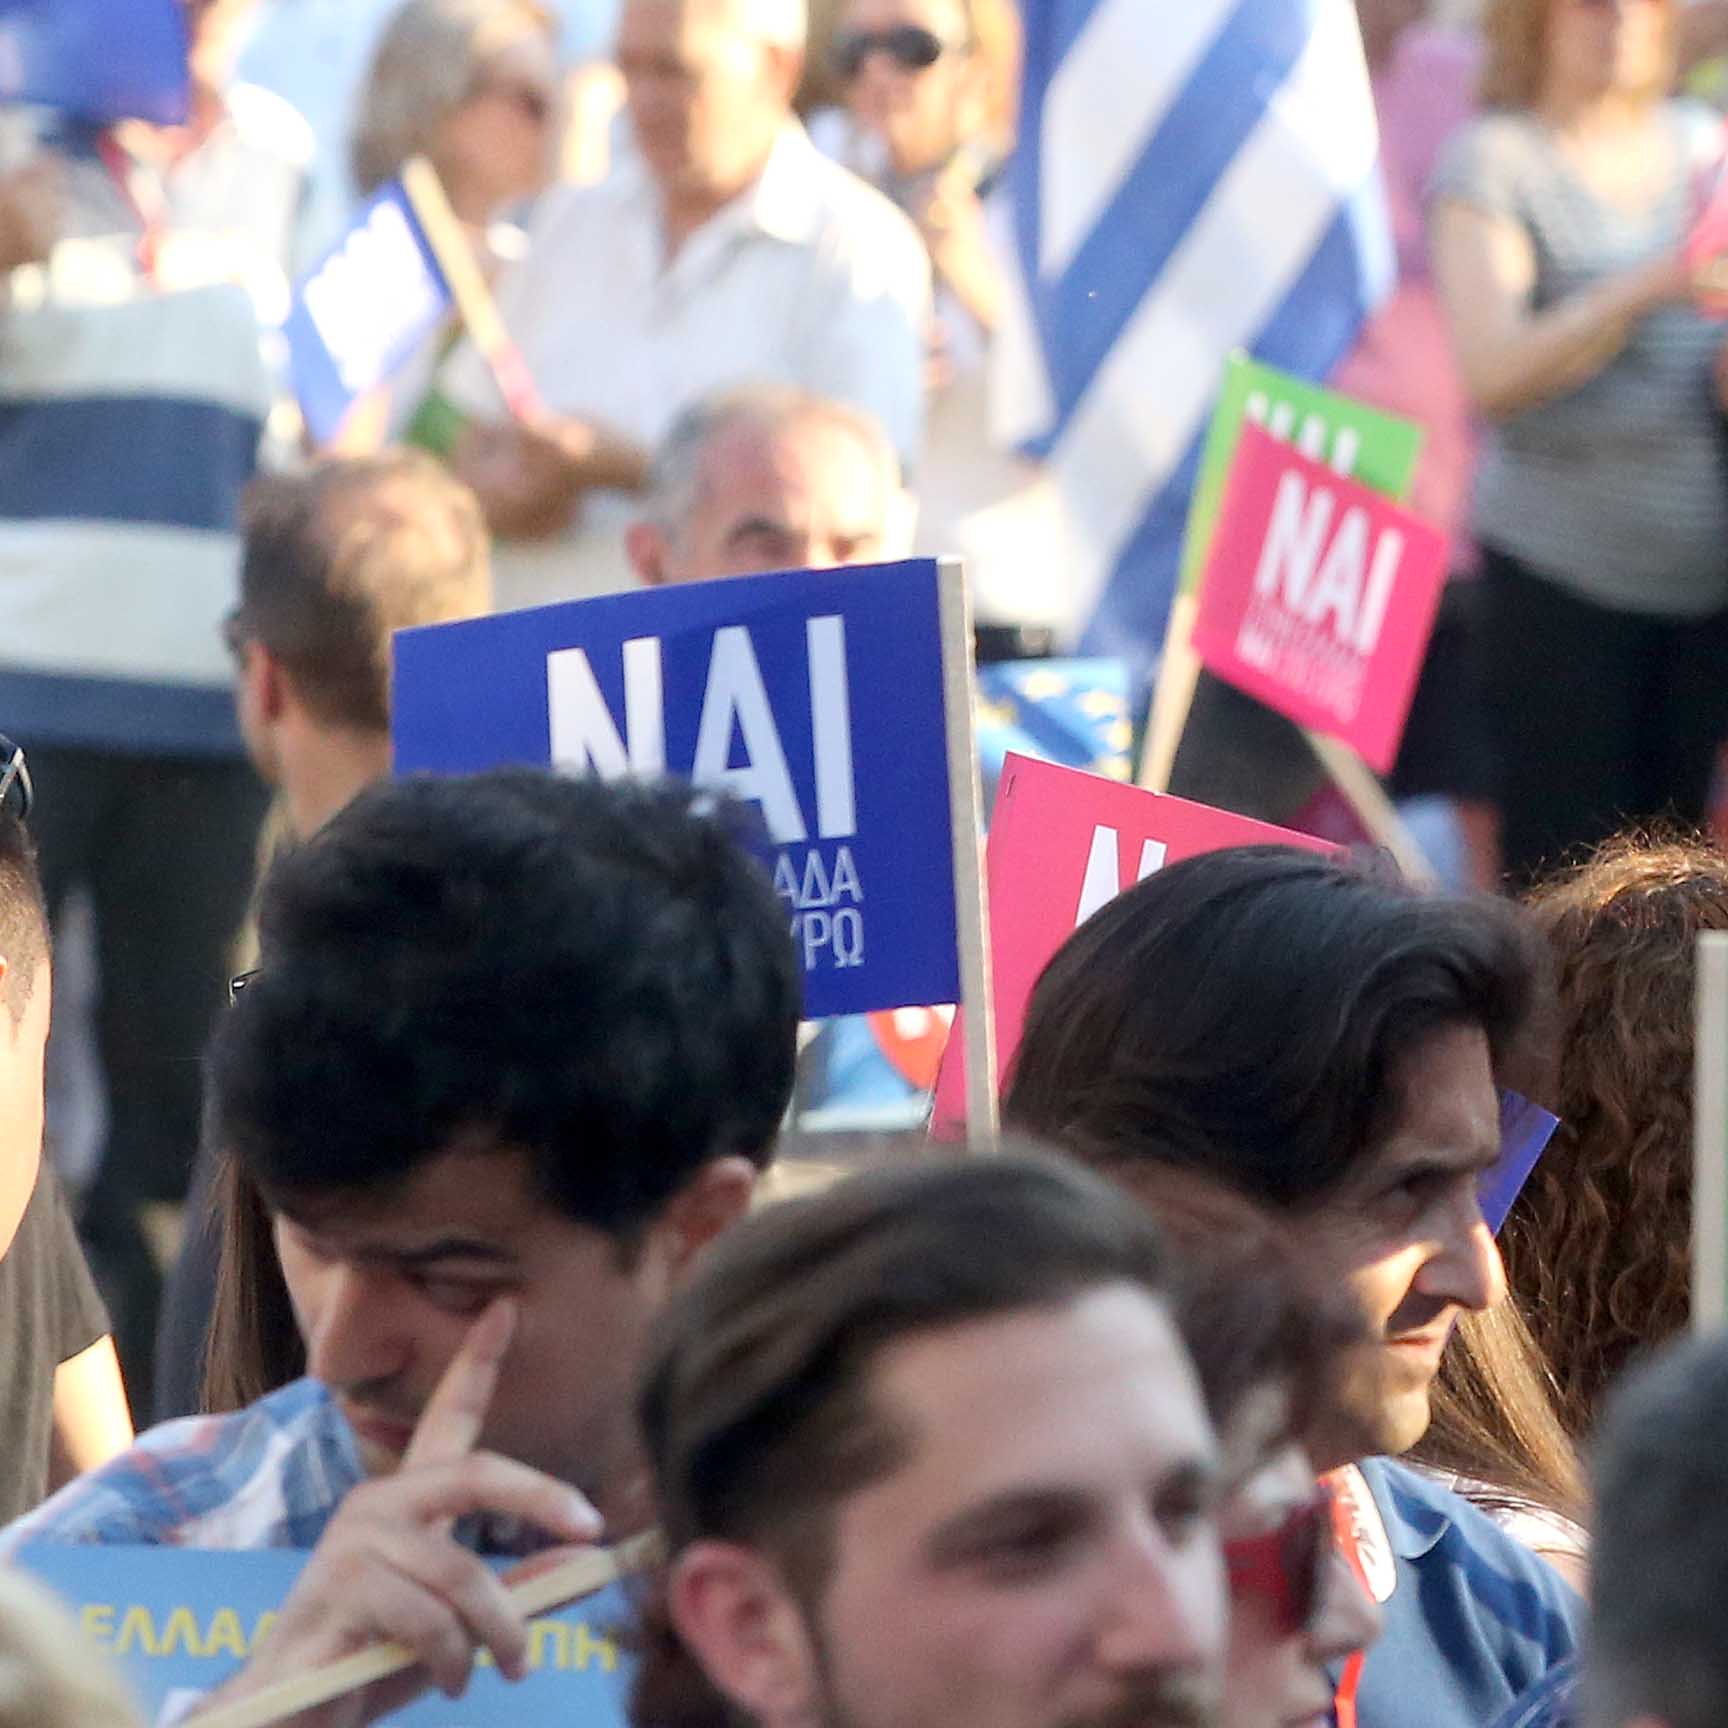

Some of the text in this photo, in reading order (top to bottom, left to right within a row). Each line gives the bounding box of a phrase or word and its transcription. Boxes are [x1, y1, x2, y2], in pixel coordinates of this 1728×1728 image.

[1254, 469, 1404, 656] ΝΑΙ
[774, 845, 864, 910] ΑΔΑ
[82, 1602, 280, 1658] ΕΛΛΑ
